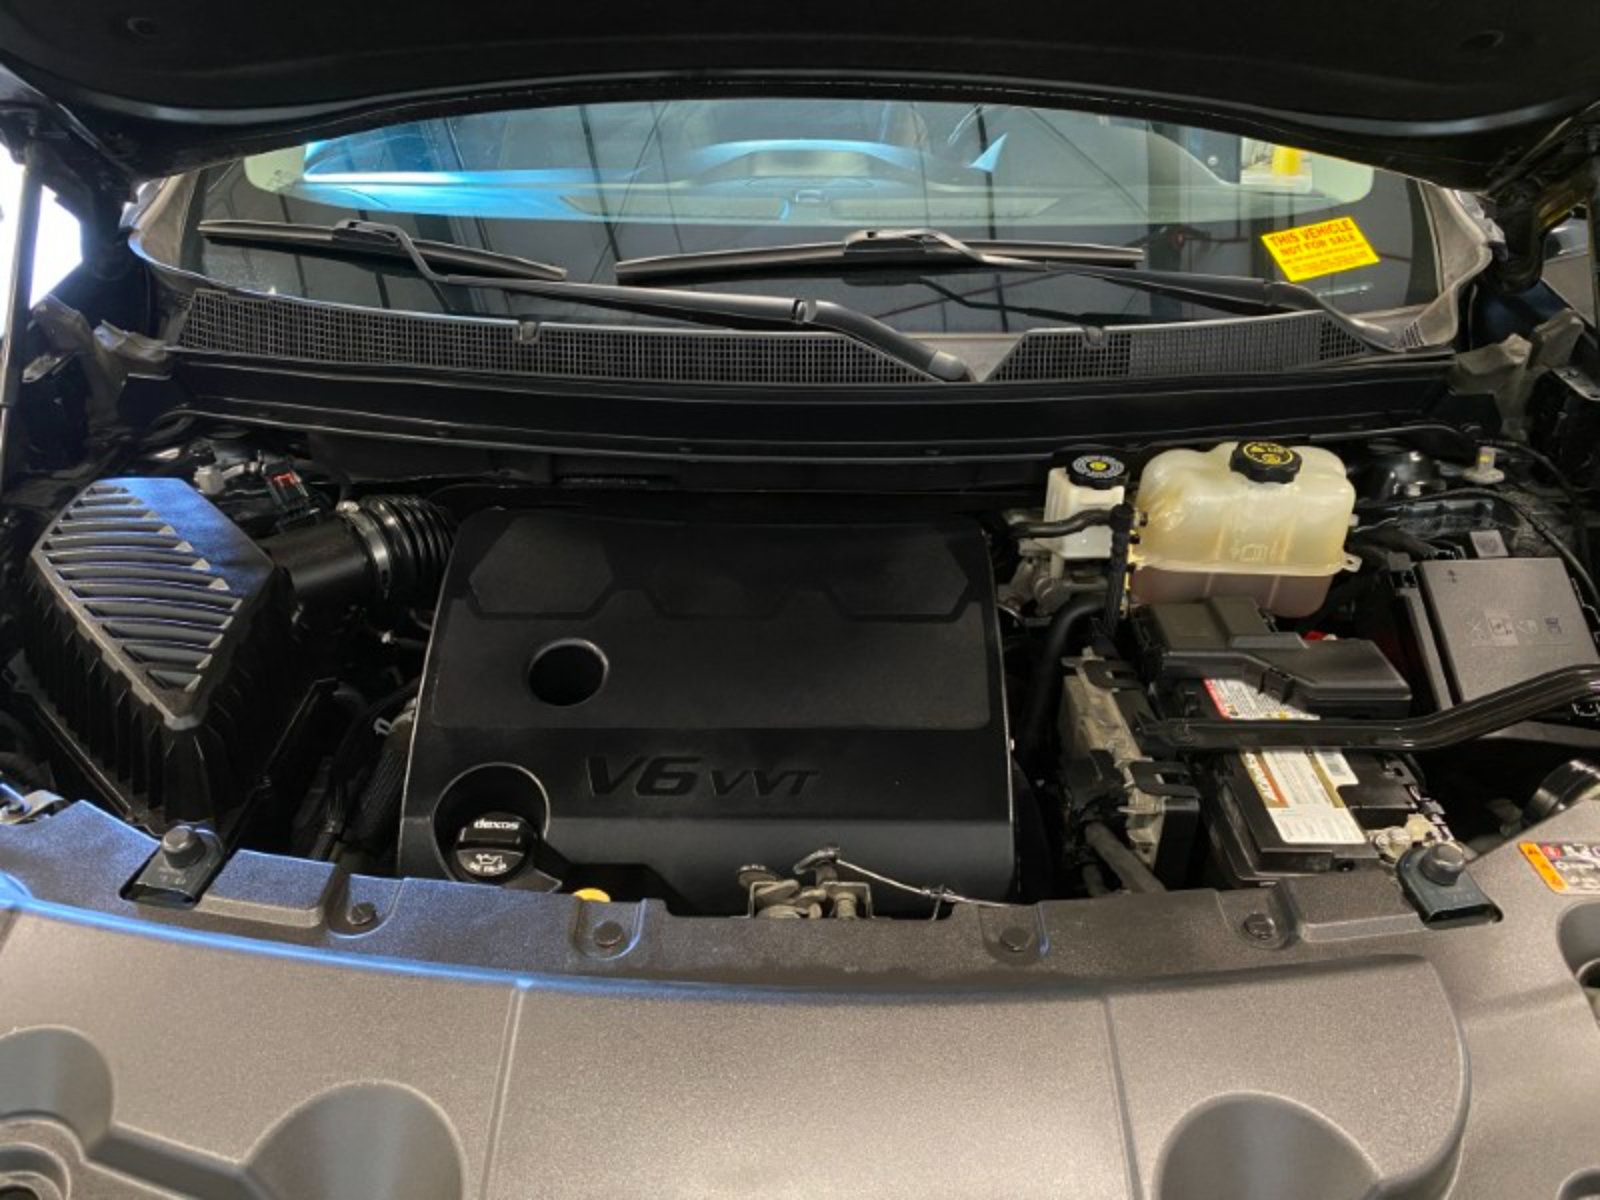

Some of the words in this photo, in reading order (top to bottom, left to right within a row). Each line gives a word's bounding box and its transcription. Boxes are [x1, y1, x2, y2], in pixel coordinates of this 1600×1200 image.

[1269, 232, 1300, 247] THIS
[1303, 220, 1353, 240] VEHICLE
[1279, 245, 1302, 257] NOT
[1304, 240, 1328, 251] FOR
[1329, 232, 1355, 246] SALE
[586, 755, 701, 797] V6
[710, 769, 820, 797] VVT
[473, 818, 520, 830] dexos
